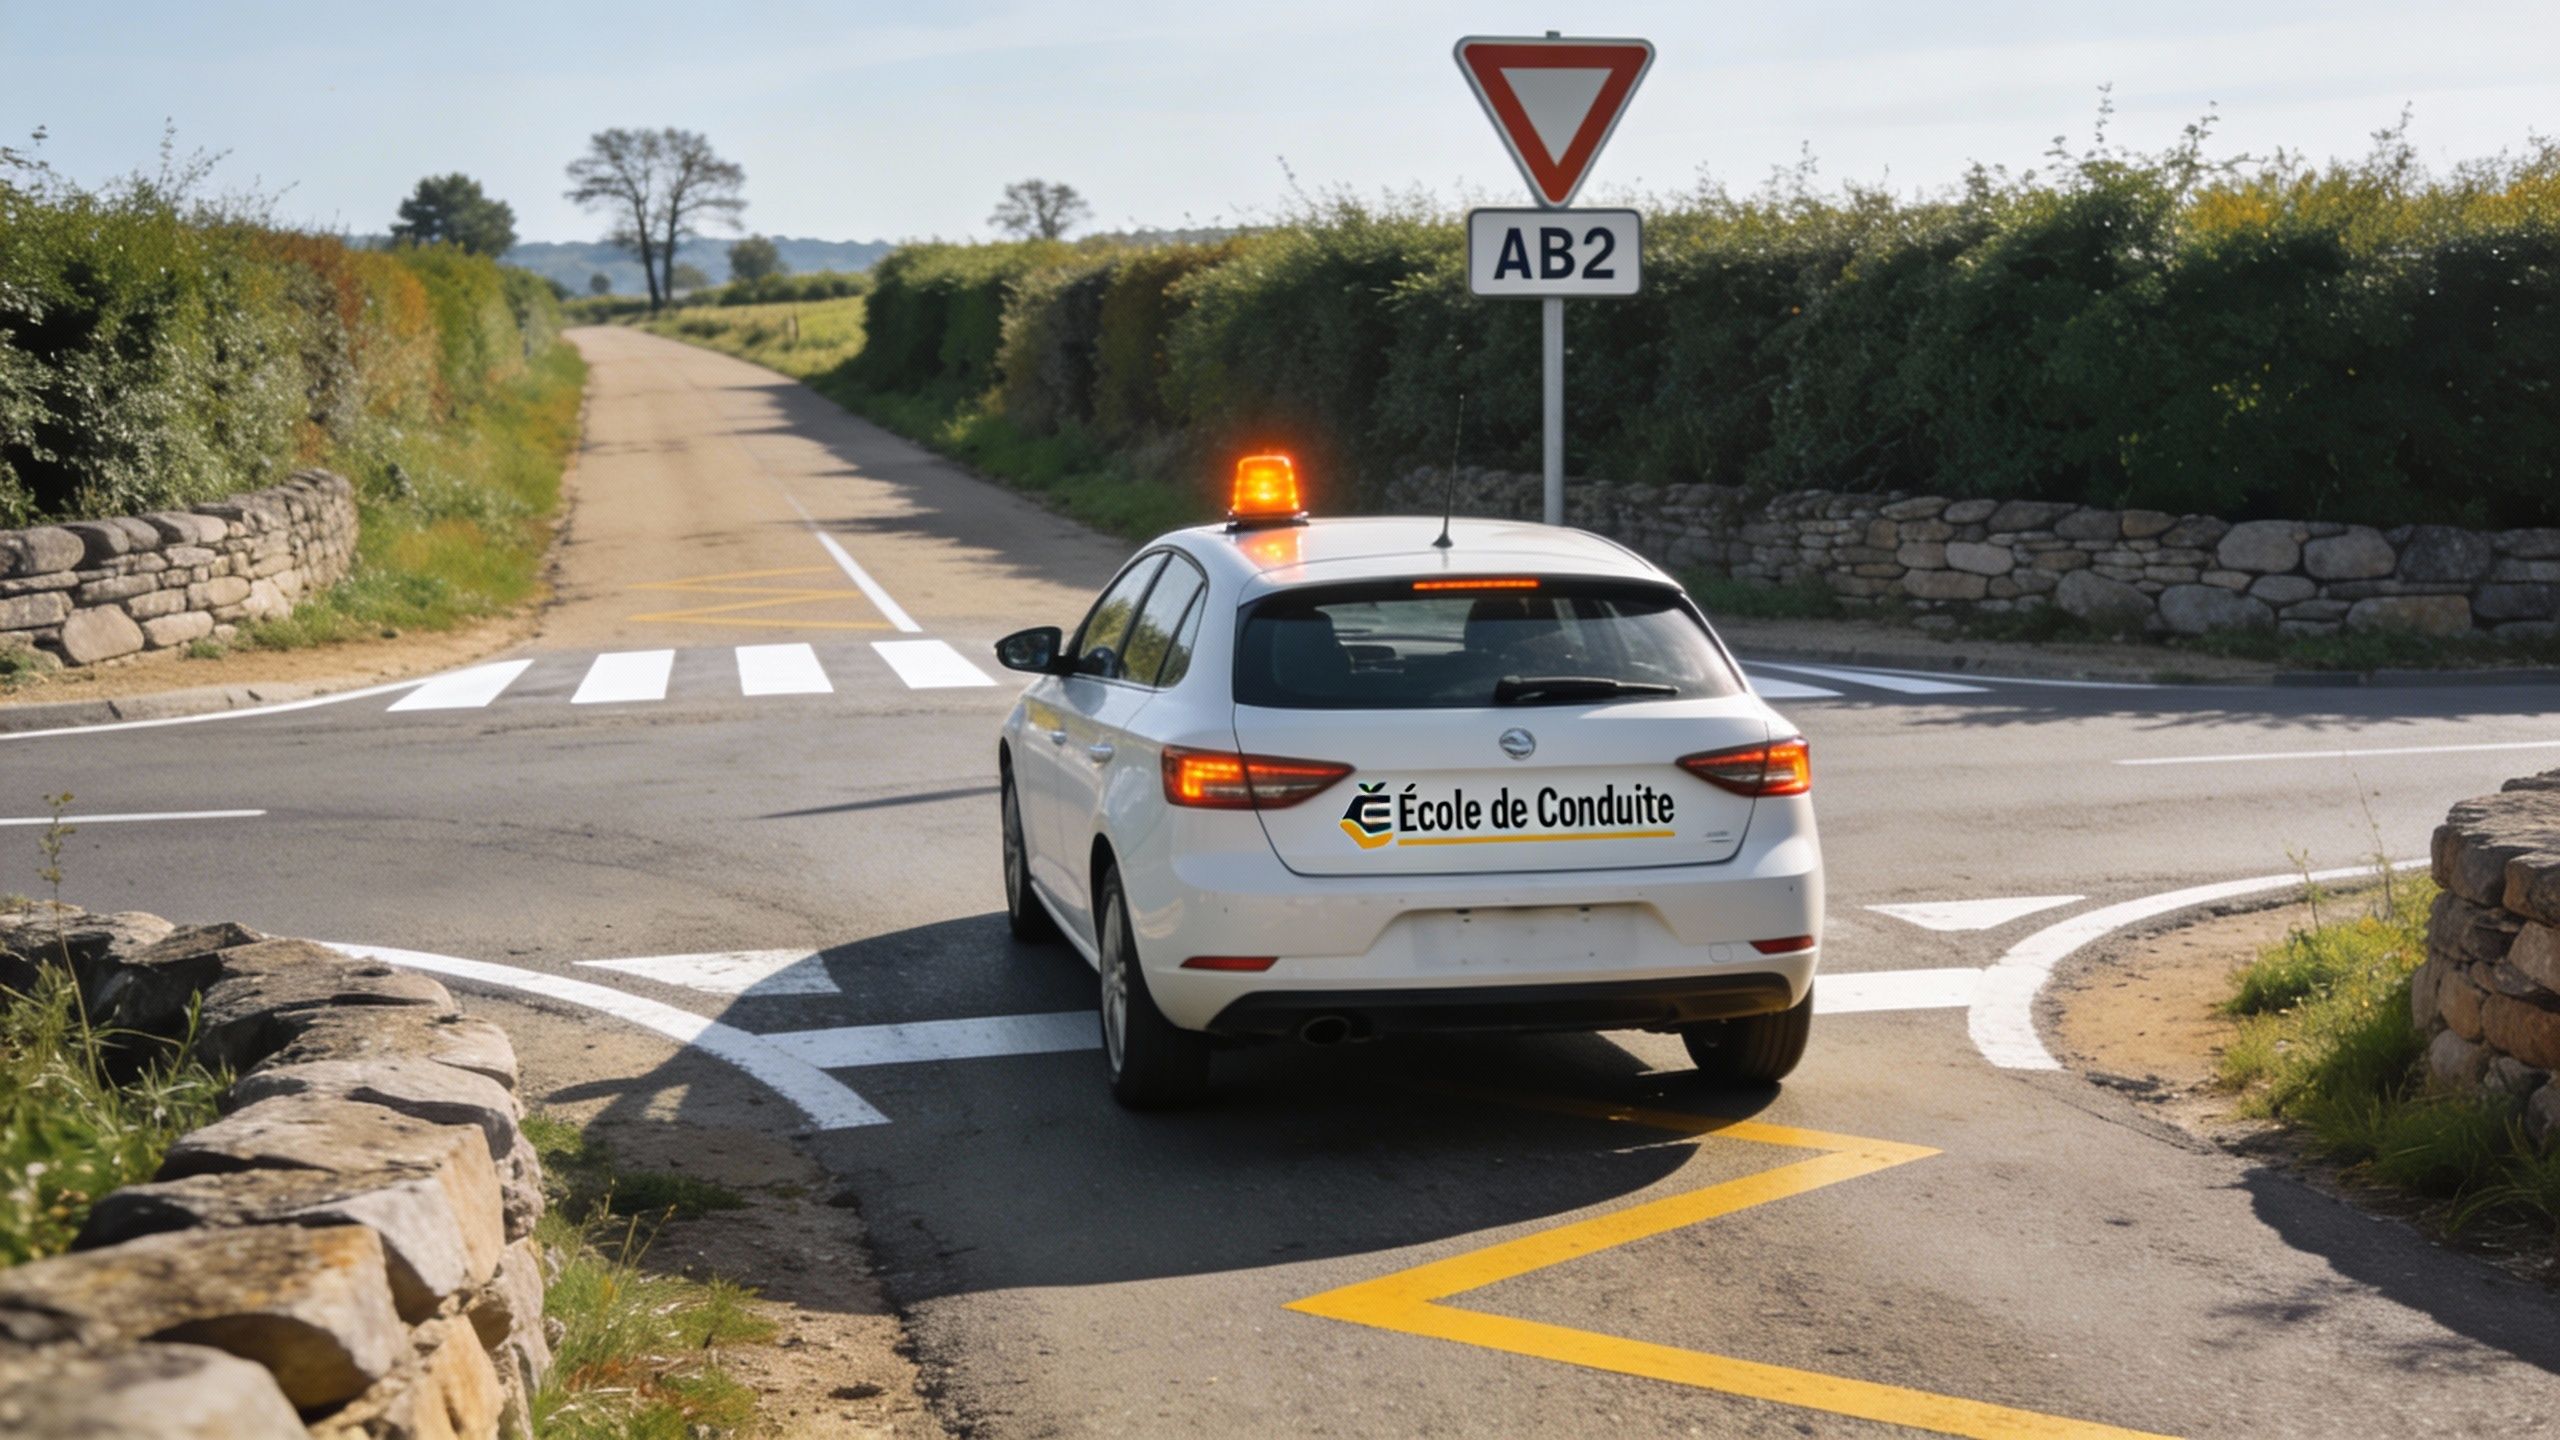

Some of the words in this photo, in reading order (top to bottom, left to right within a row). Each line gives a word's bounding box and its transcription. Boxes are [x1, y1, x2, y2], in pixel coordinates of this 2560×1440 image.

[1493, 226, 1616, 280] AB2
[1398, 783, 1482, 832] École
[1491, 787, 1528, 830] de
[1537, 783, 1675, 828] Conduite
